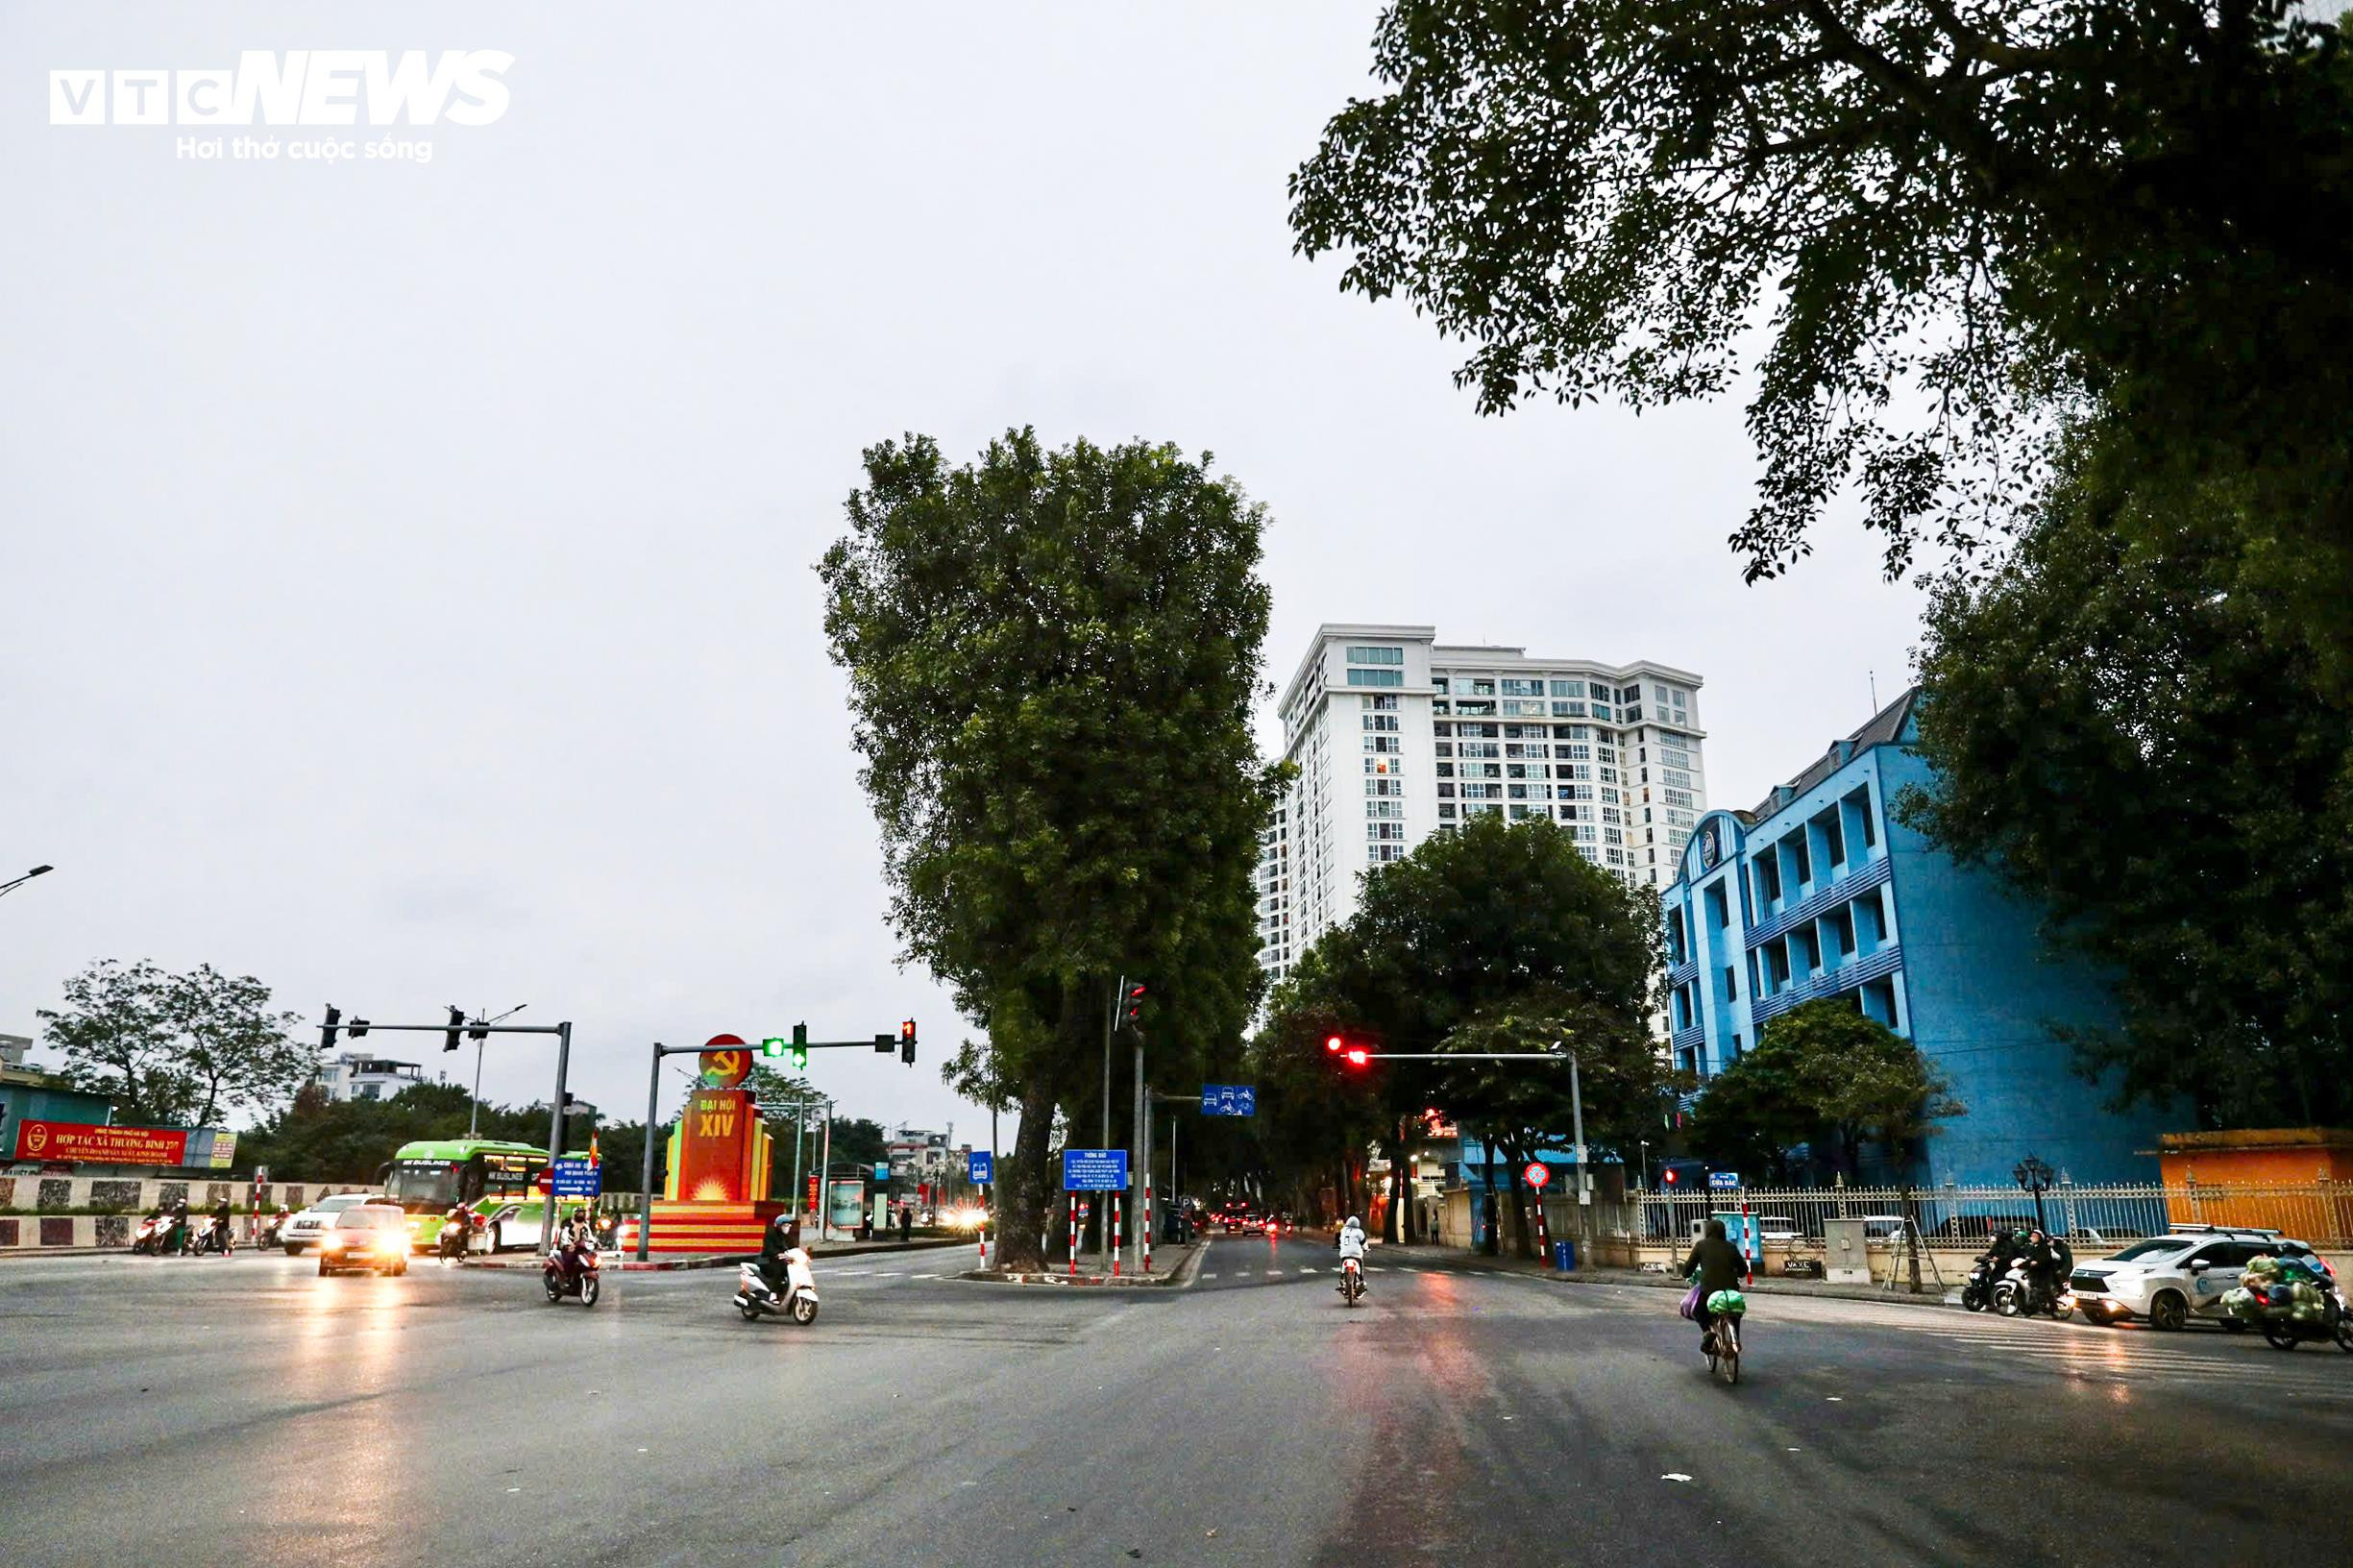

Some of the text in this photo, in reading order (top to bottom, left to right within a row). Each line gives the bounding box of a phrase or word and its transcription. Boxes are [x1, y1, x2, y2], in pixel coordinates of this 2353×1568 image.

[700, 1097, 736, 1113] ĐẠI HỘI
[699, 1115, 734, 1138] XIV
[57, 1134, 75, 1146] HỢP
[78, 1133, 95, 1145] TÁC
[96, 1135, 108, 1146] XÃ
[1183, 1198, 1190, 1208] P
